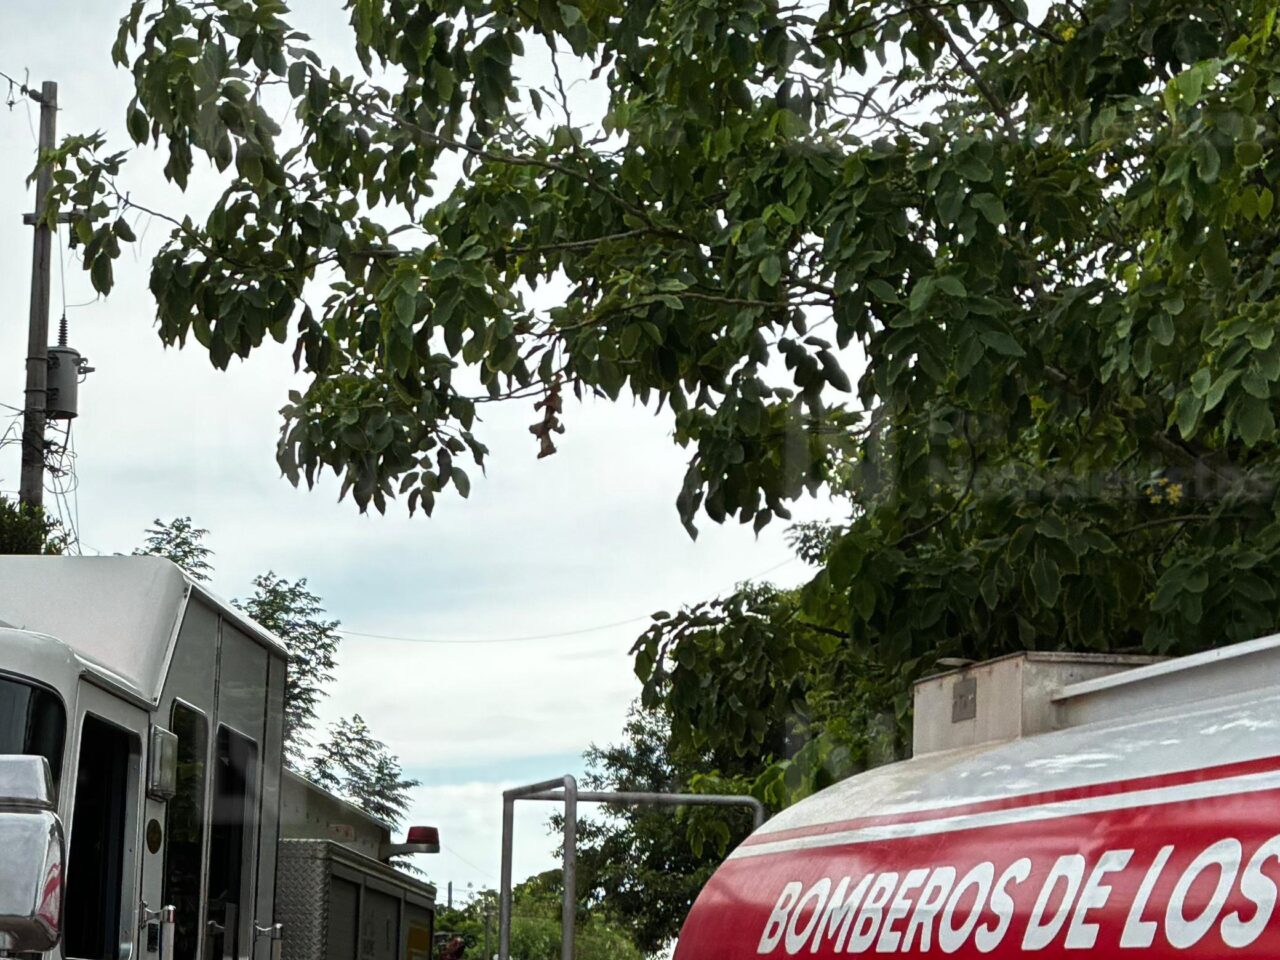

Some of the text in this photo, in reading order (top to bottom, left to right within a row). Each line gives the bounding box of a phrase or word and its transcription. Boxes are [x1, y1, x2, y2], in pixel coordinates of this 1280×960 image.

[756, 834, 1280, 955] BOMBEROS DE LOS
